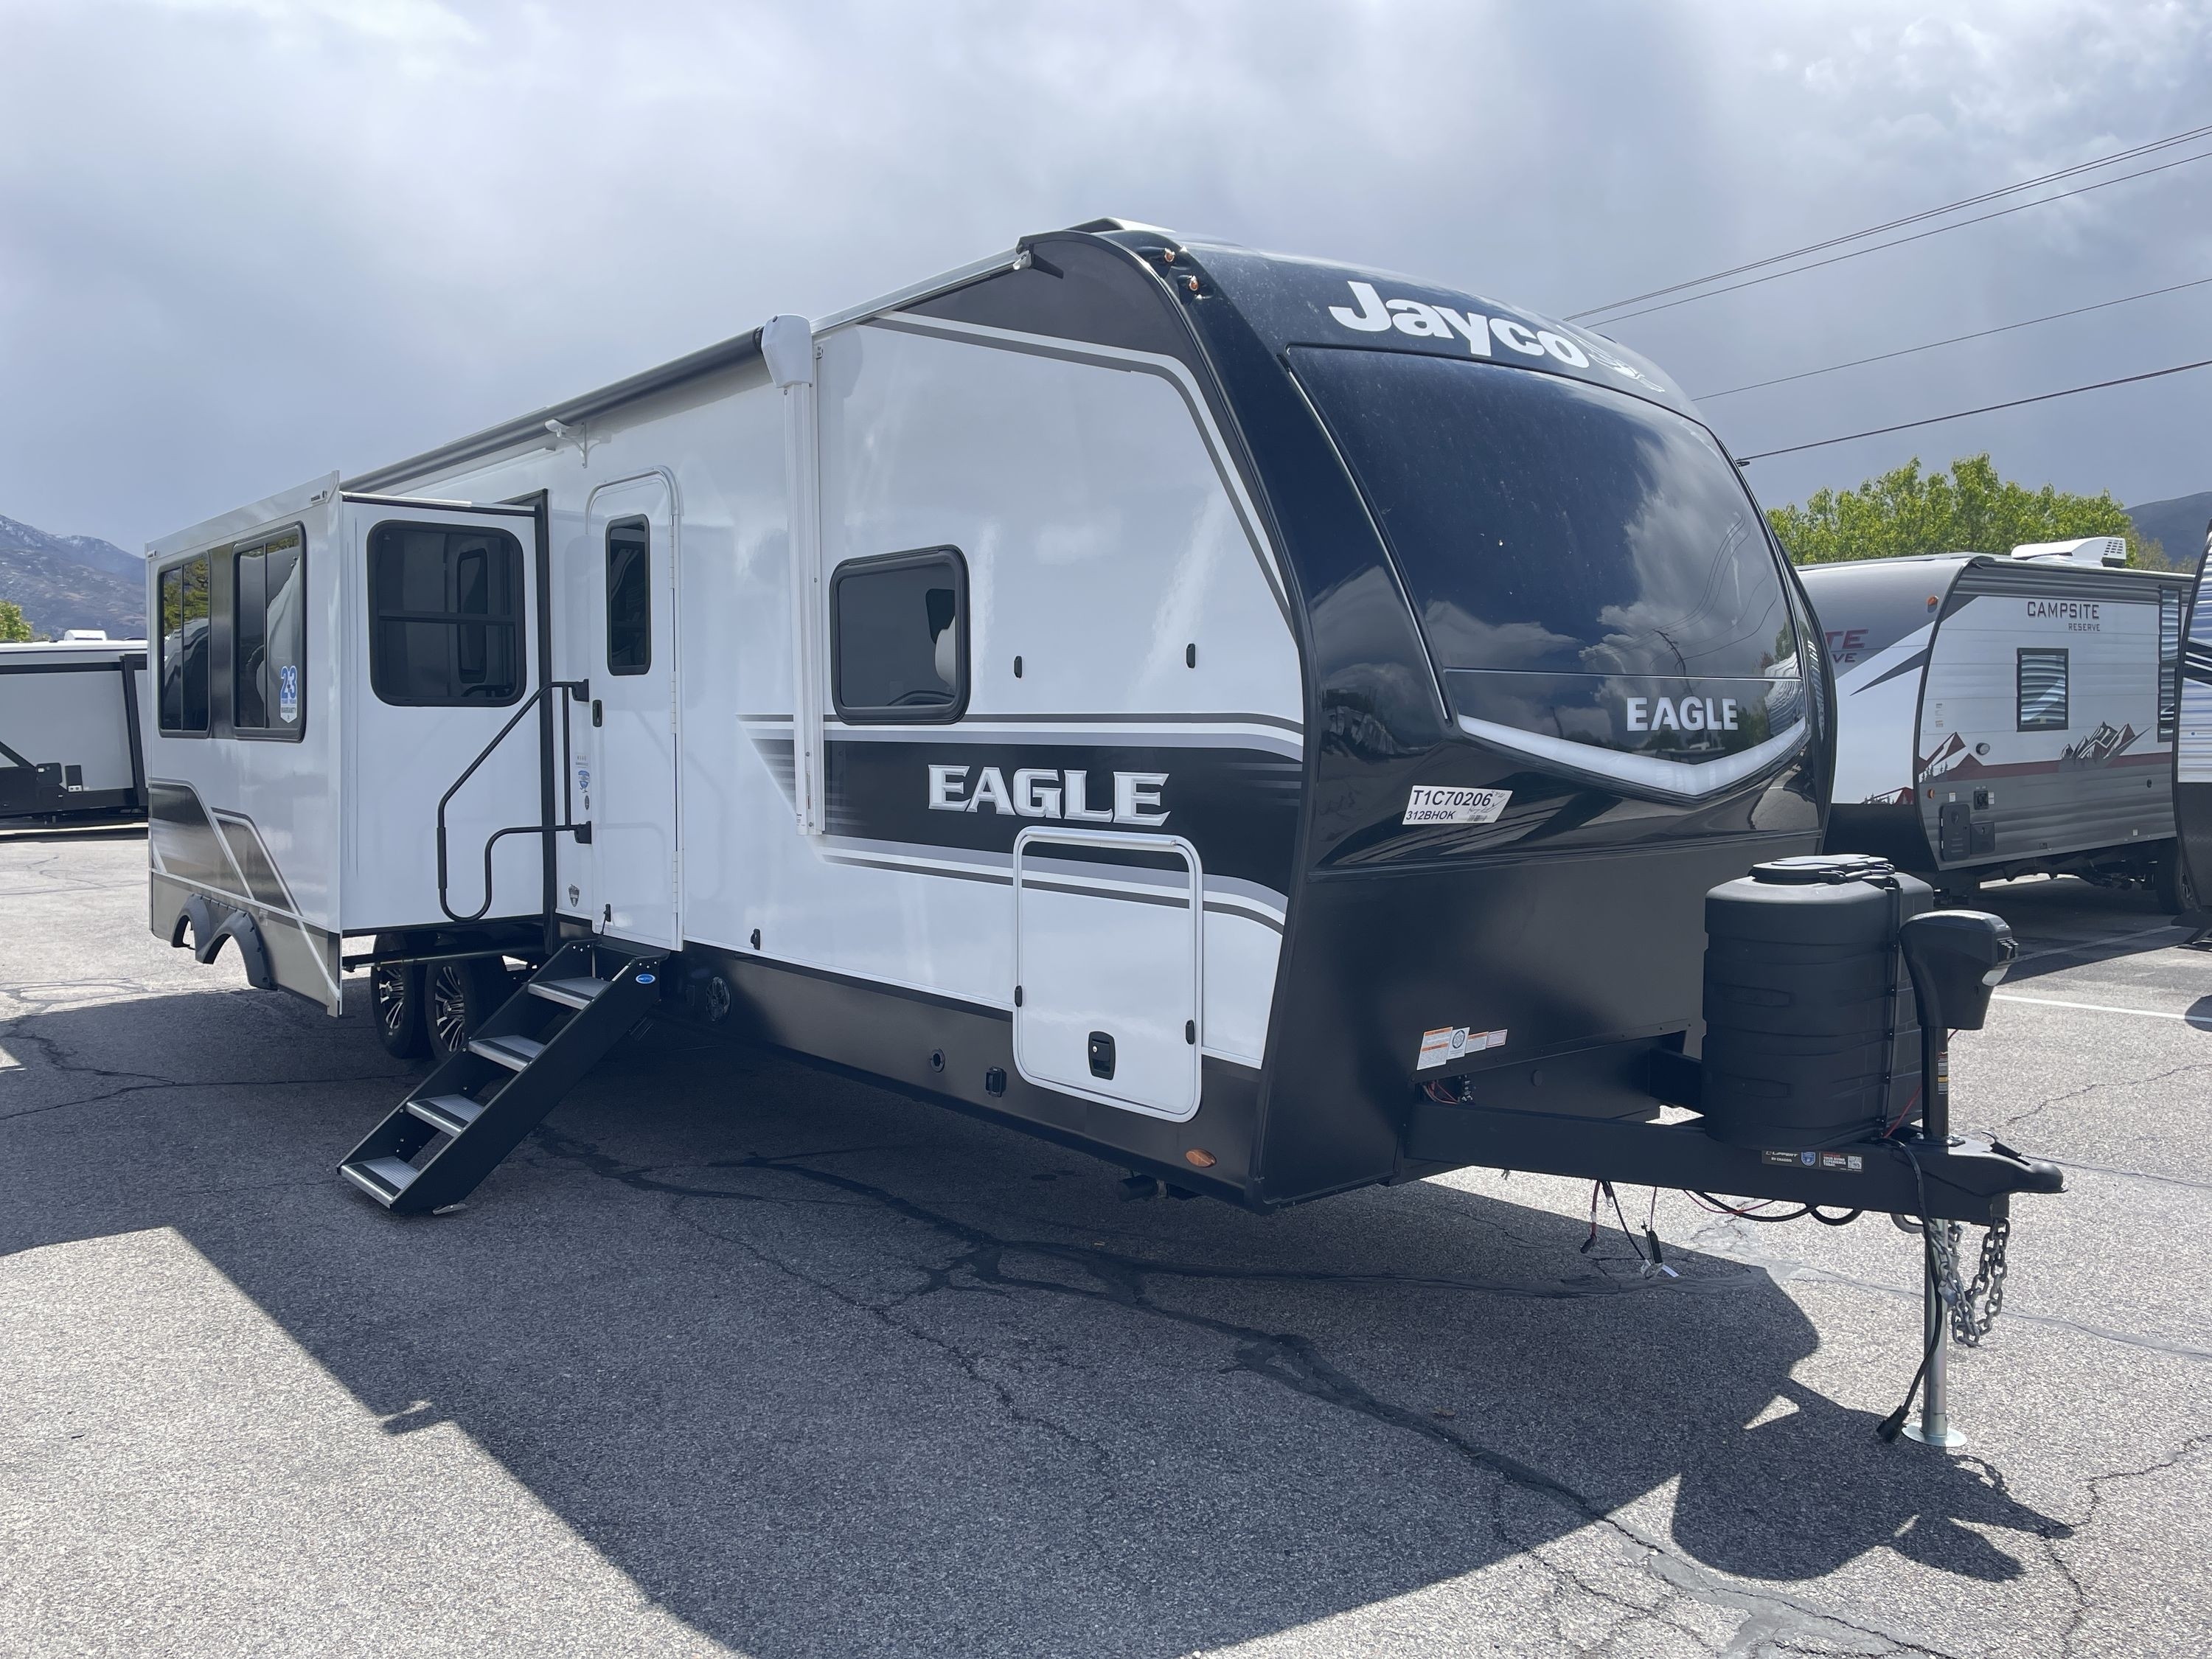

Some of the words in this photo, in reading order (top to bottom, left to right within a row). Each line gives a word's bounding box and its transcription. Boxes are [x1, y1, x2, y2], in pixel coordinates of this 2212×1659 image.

[1328, 280, 1589, 369] Jayco
[2028, 601, 2100, 619] CAMPSITE
[2067, 622, 2101, 632] RESERVE
[1627, 695, 1739, 731] EAGLE
[928, 764, 1172, 827] EAGLE
[1413, 790, 1493, 807] T1C70206
[1405, 810, 1456, 821] 312BHOK
